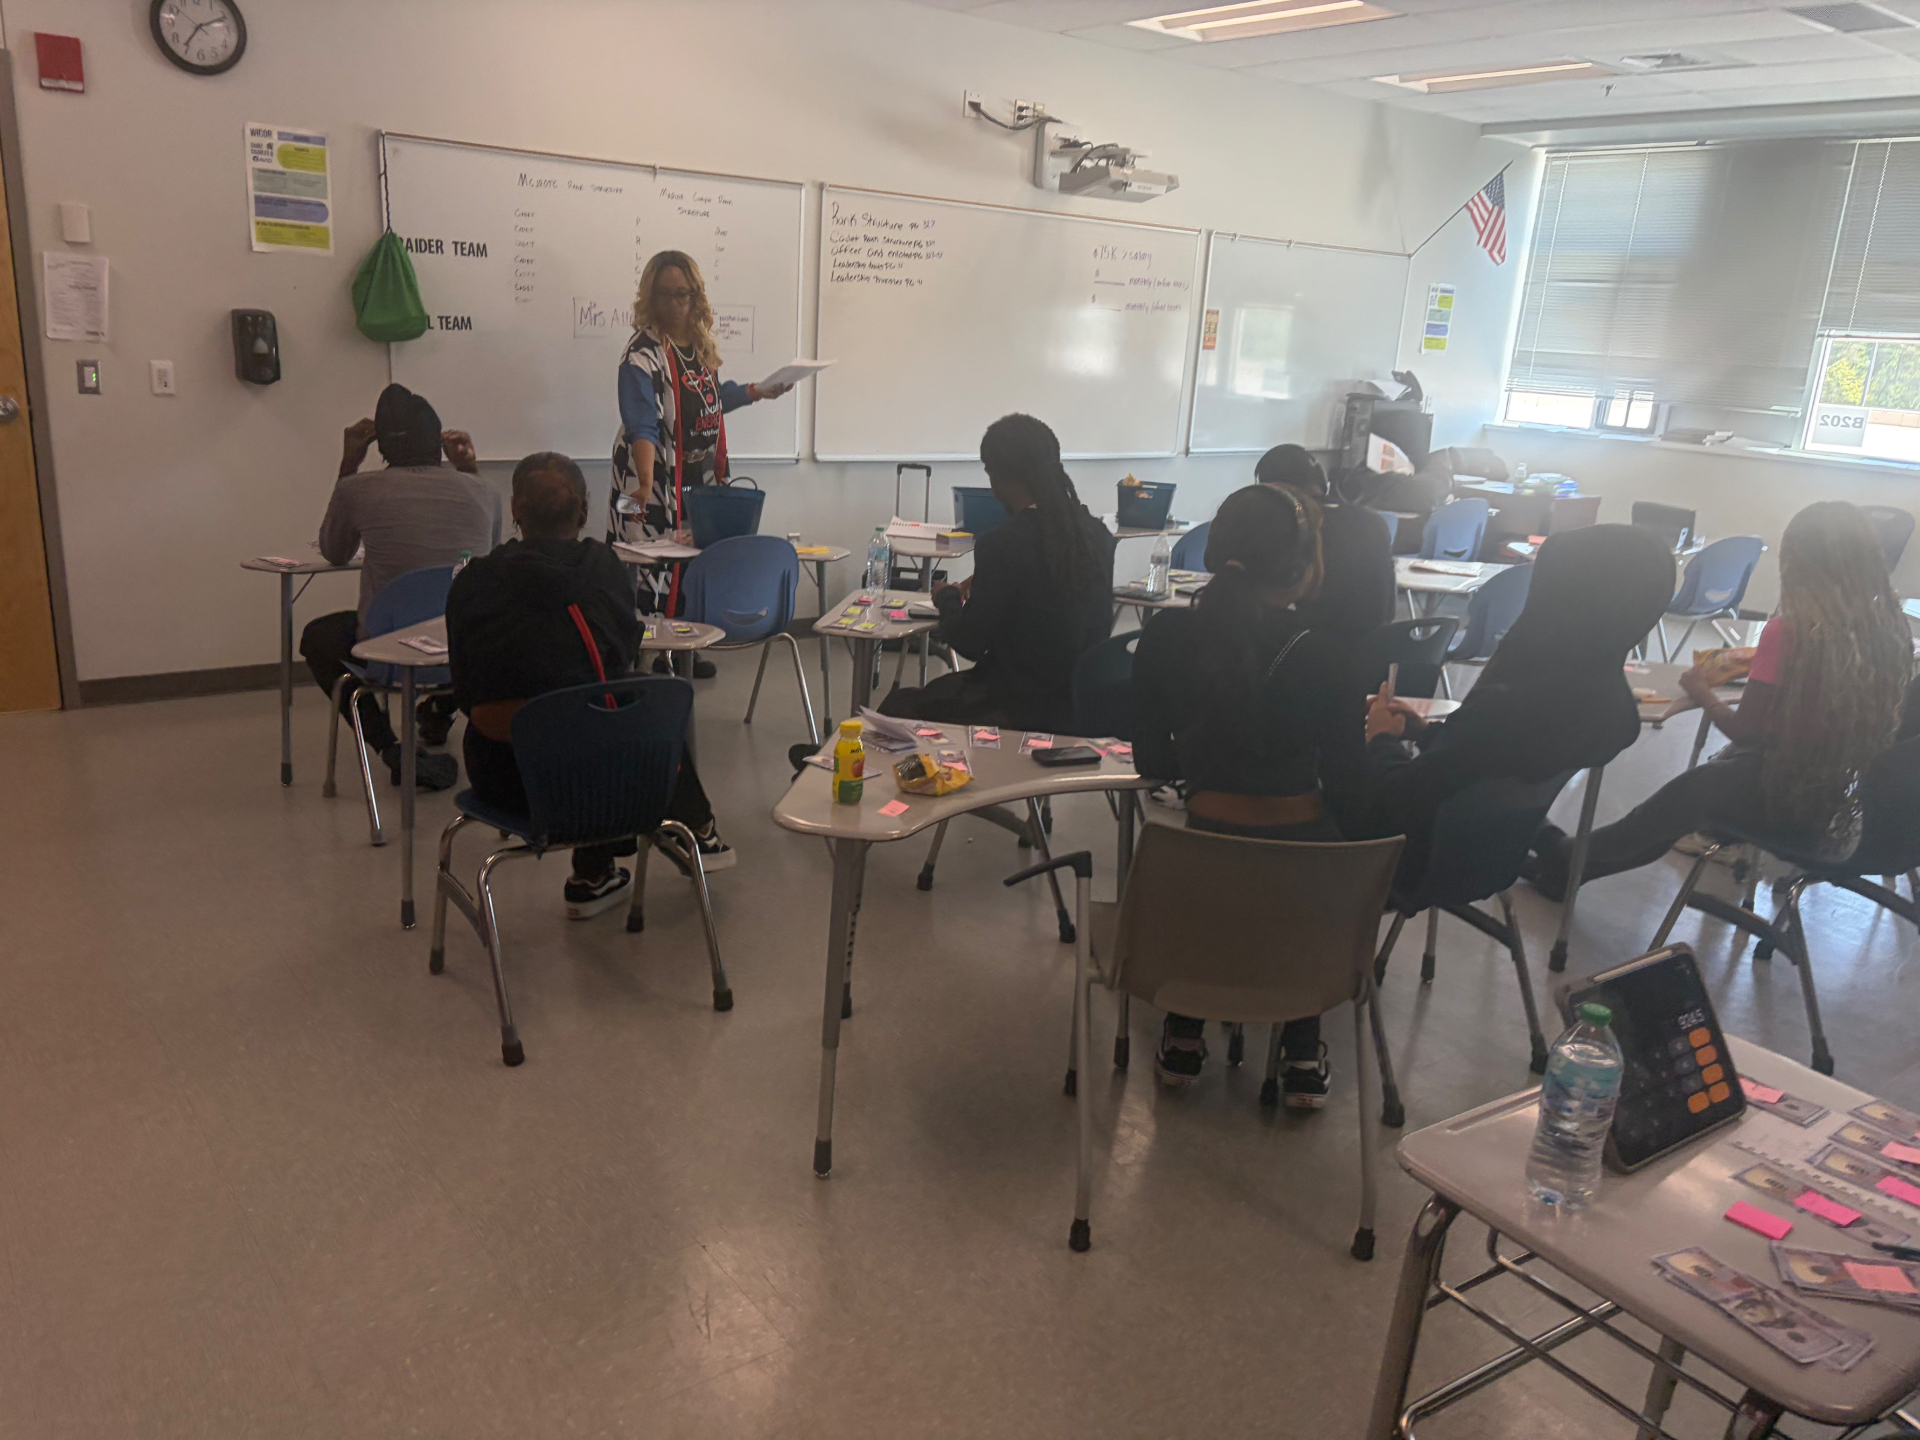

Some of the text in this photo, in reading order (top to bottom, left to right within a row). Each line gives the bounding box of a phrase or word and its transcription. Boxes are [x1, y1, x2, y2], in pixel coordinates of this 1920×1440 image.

[197, 49, 205, 61] 6
[831, 201, 857, 228] Rank
[398, 237, 488, 258] AIDER TEAM
[437, 315, 472, 331] TEAM
[610, 309, 635, 328] Alle
